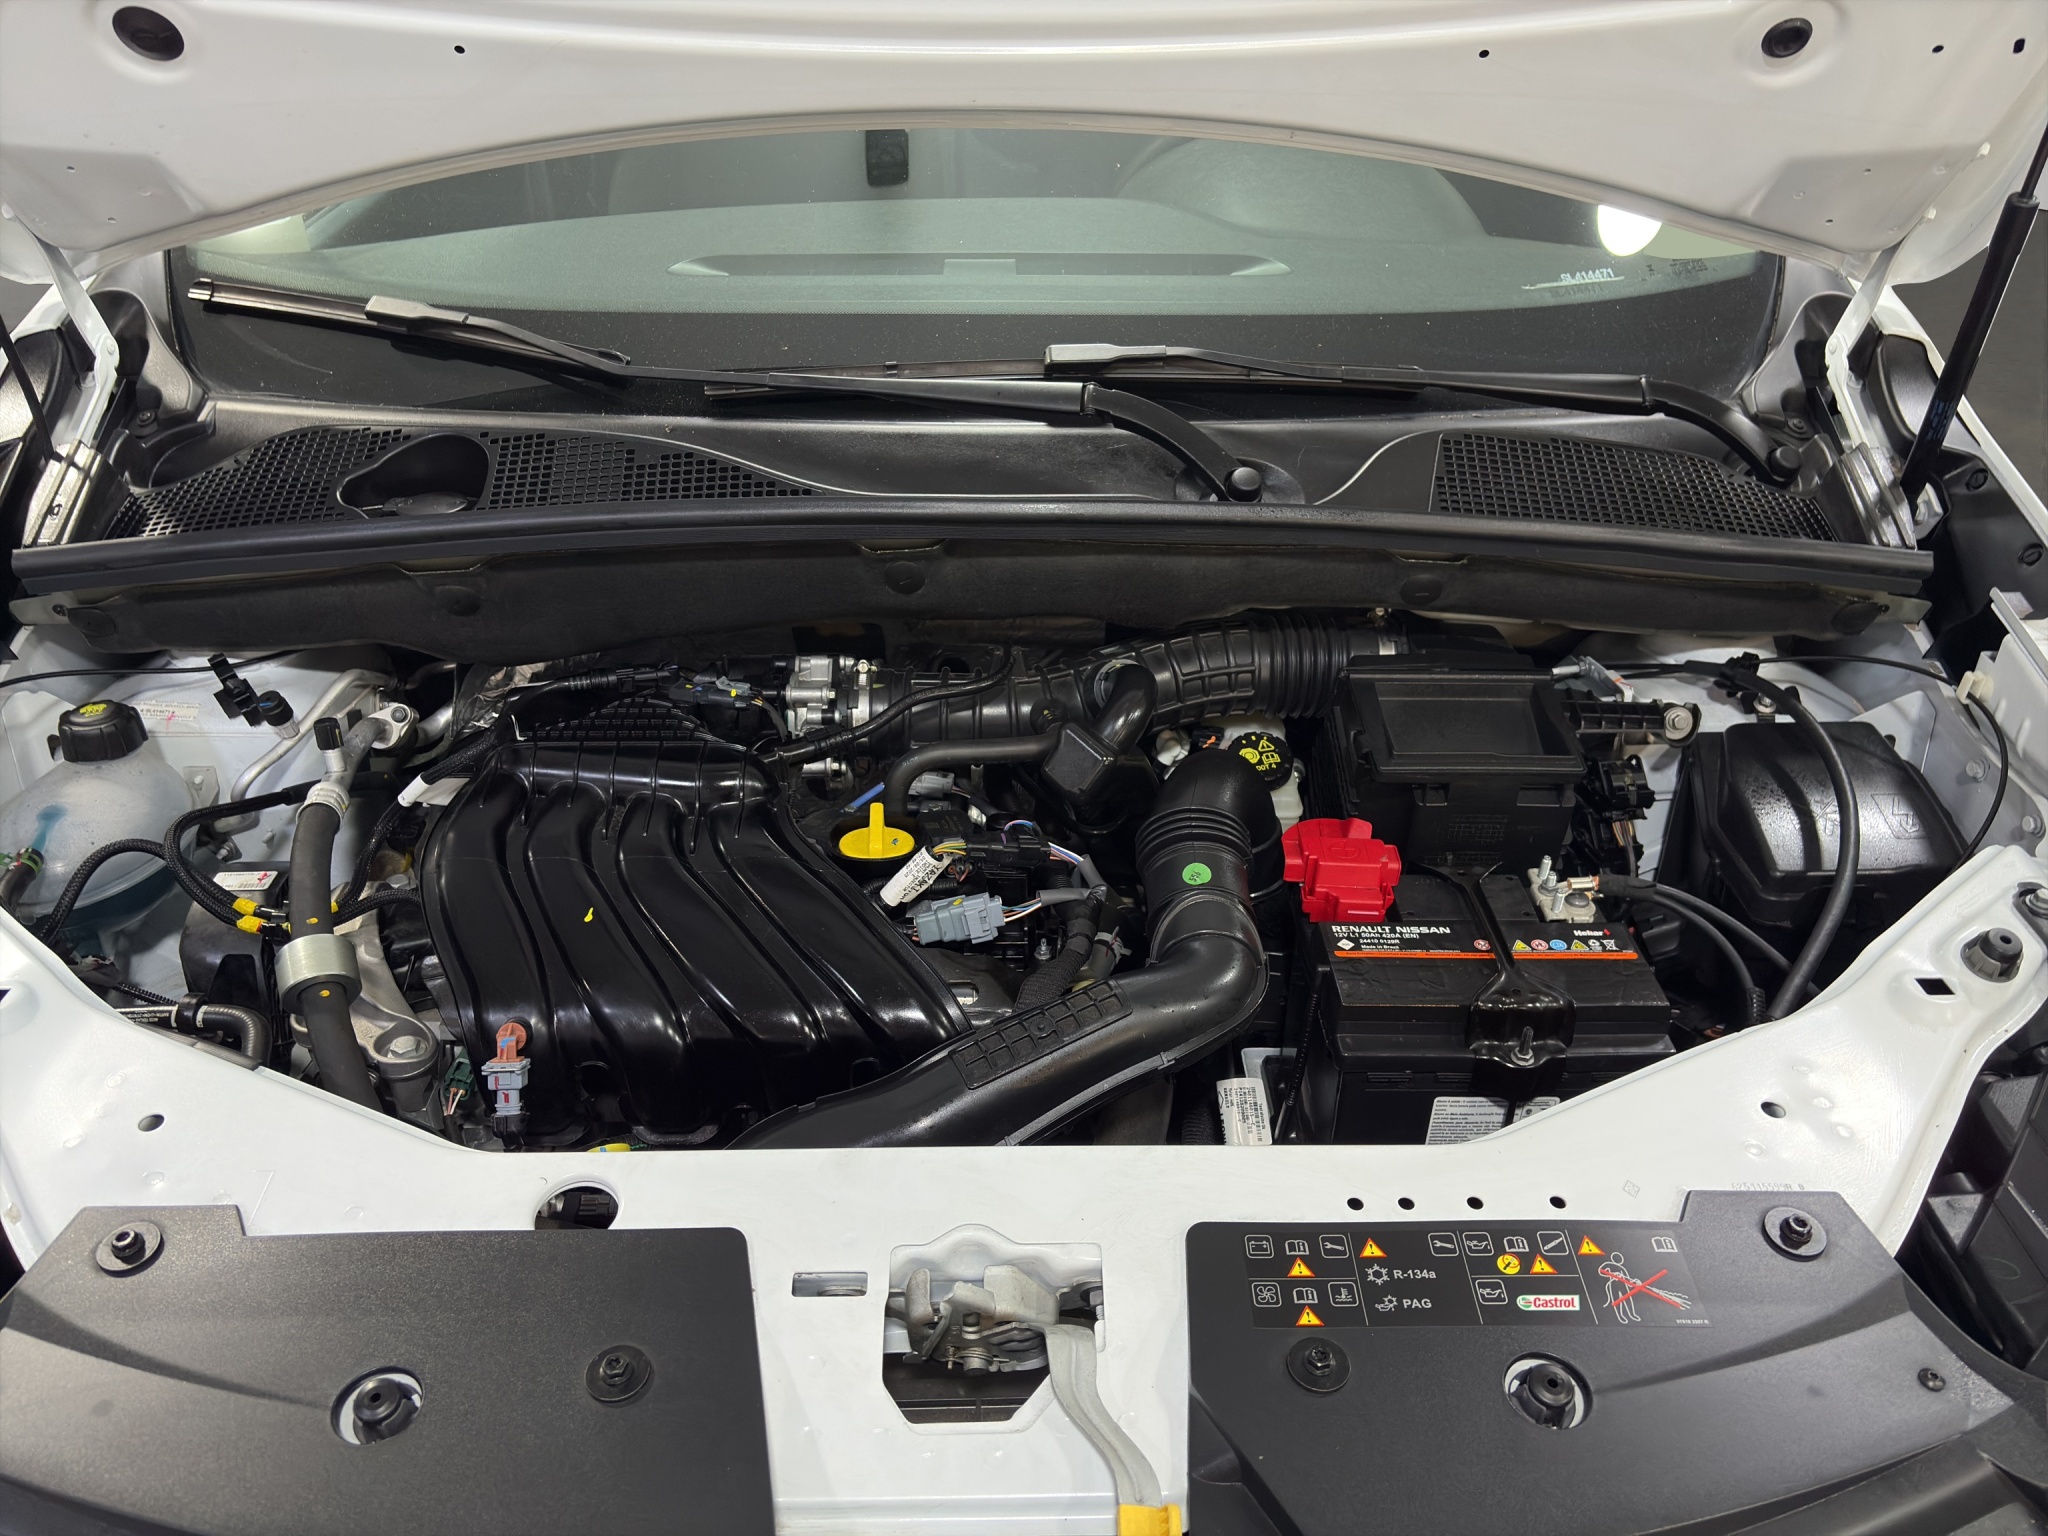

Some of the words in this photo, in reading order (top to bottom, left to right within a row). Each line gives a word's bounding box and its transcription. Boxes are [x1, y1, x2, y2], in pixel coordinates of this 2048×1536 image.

[1331, 925, 1391, 933] RENAULT
[1395, 926, 1451, 934] NISSAN
[1393, 1269, 1437, 1279] R-134a
[1403, 1299, 1432, 1309] PAG
[1533, 1296, 1575, 1309] Castrol
